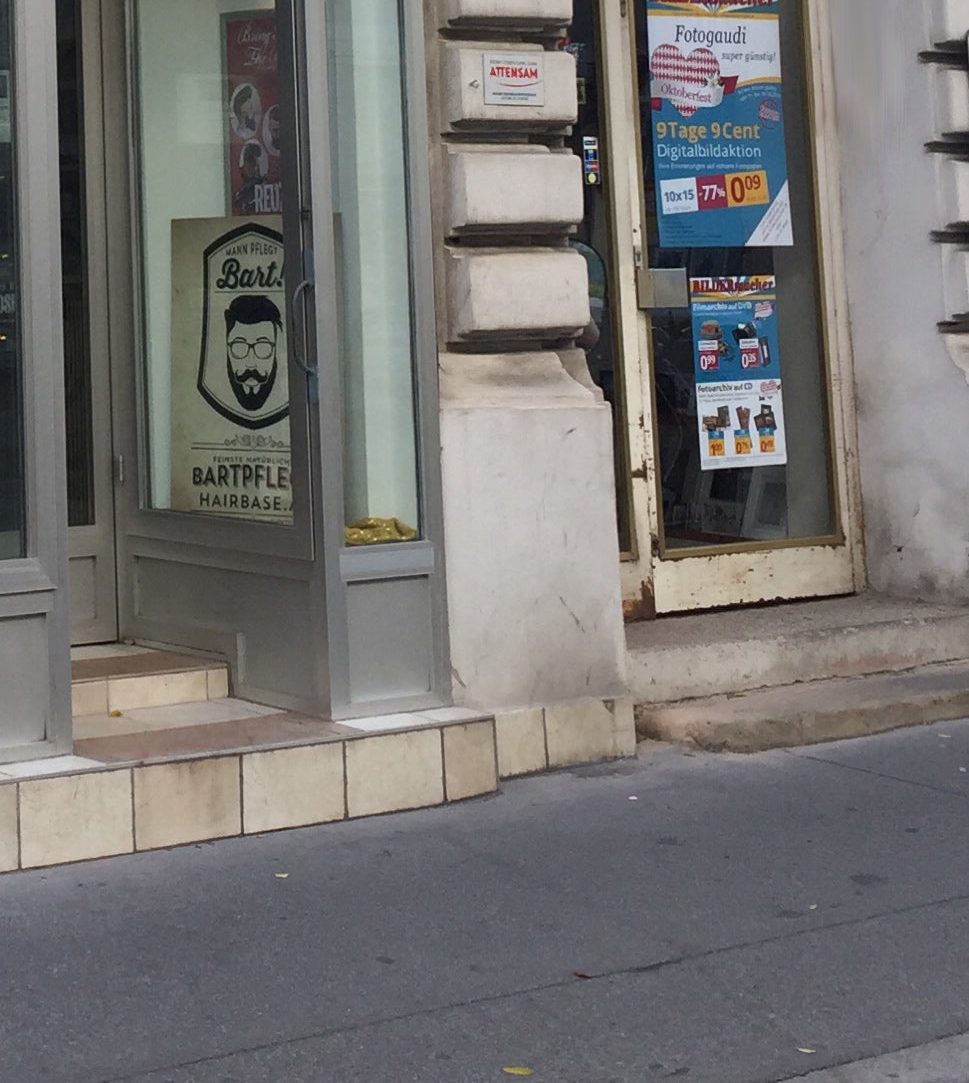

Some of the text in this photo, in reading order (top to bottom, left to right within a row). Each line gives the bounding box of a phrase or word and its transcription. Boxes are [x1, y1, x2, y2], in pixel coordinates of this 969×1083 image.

[675, 24, 746, 47] Fotogaudi
[721, 50, 776, 63] super günstig!
[490, 66, 538, 78] ATTENSAM
[660, 83, 712, 103] Oktoberfest
[657, 144, 761, 161] Digitalbildaktion
[254, 182, 282, 212] REU
[664, 190, 694, 202] 10x15
[698, 185, 725, 201] -77%
[226, 242, 278, 256] MANN PFLEGT
[192, 464, 292, 488] BARTPFLE
